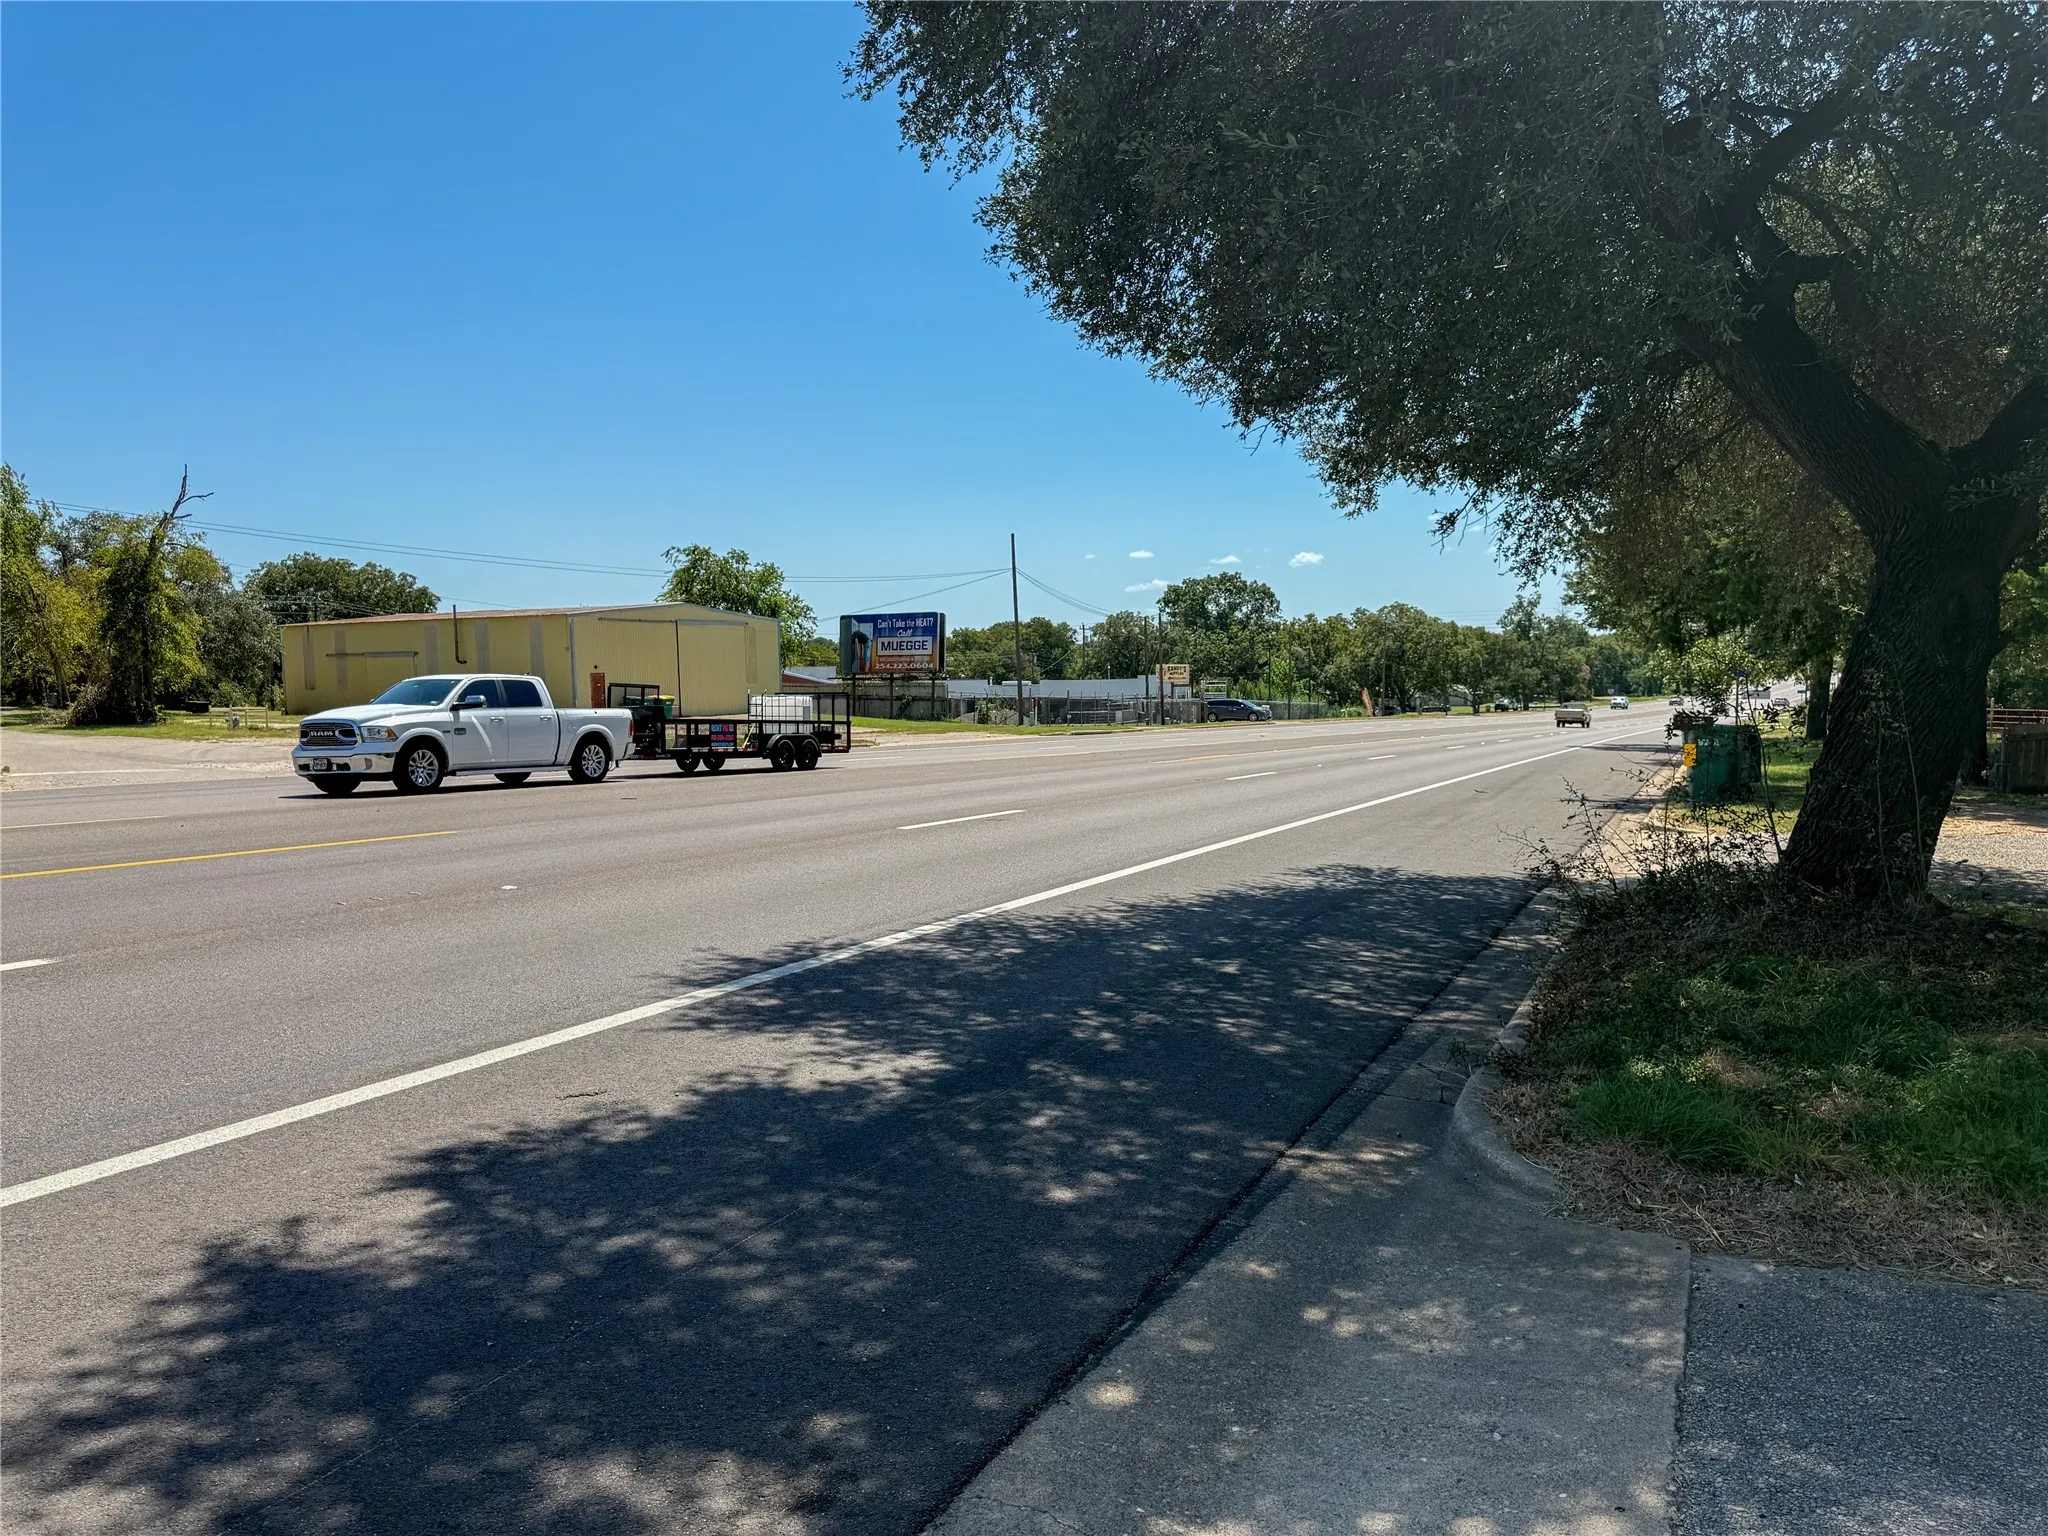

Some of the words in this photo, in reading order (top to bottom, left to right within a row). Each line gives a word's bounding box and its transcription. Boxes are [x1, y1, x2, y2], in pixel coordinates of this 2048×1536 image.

[877, 619, 892, 628] Can't
[892, 618, 905, 628] Take
[906, 618, 915, 628] the
[915, 617, 934, 627] HEAT?
[896, 629, 913, 637] Call
[881, 640, 928, 651] MUEGGE
[874, 662, 934, 670] 254.223.0604
